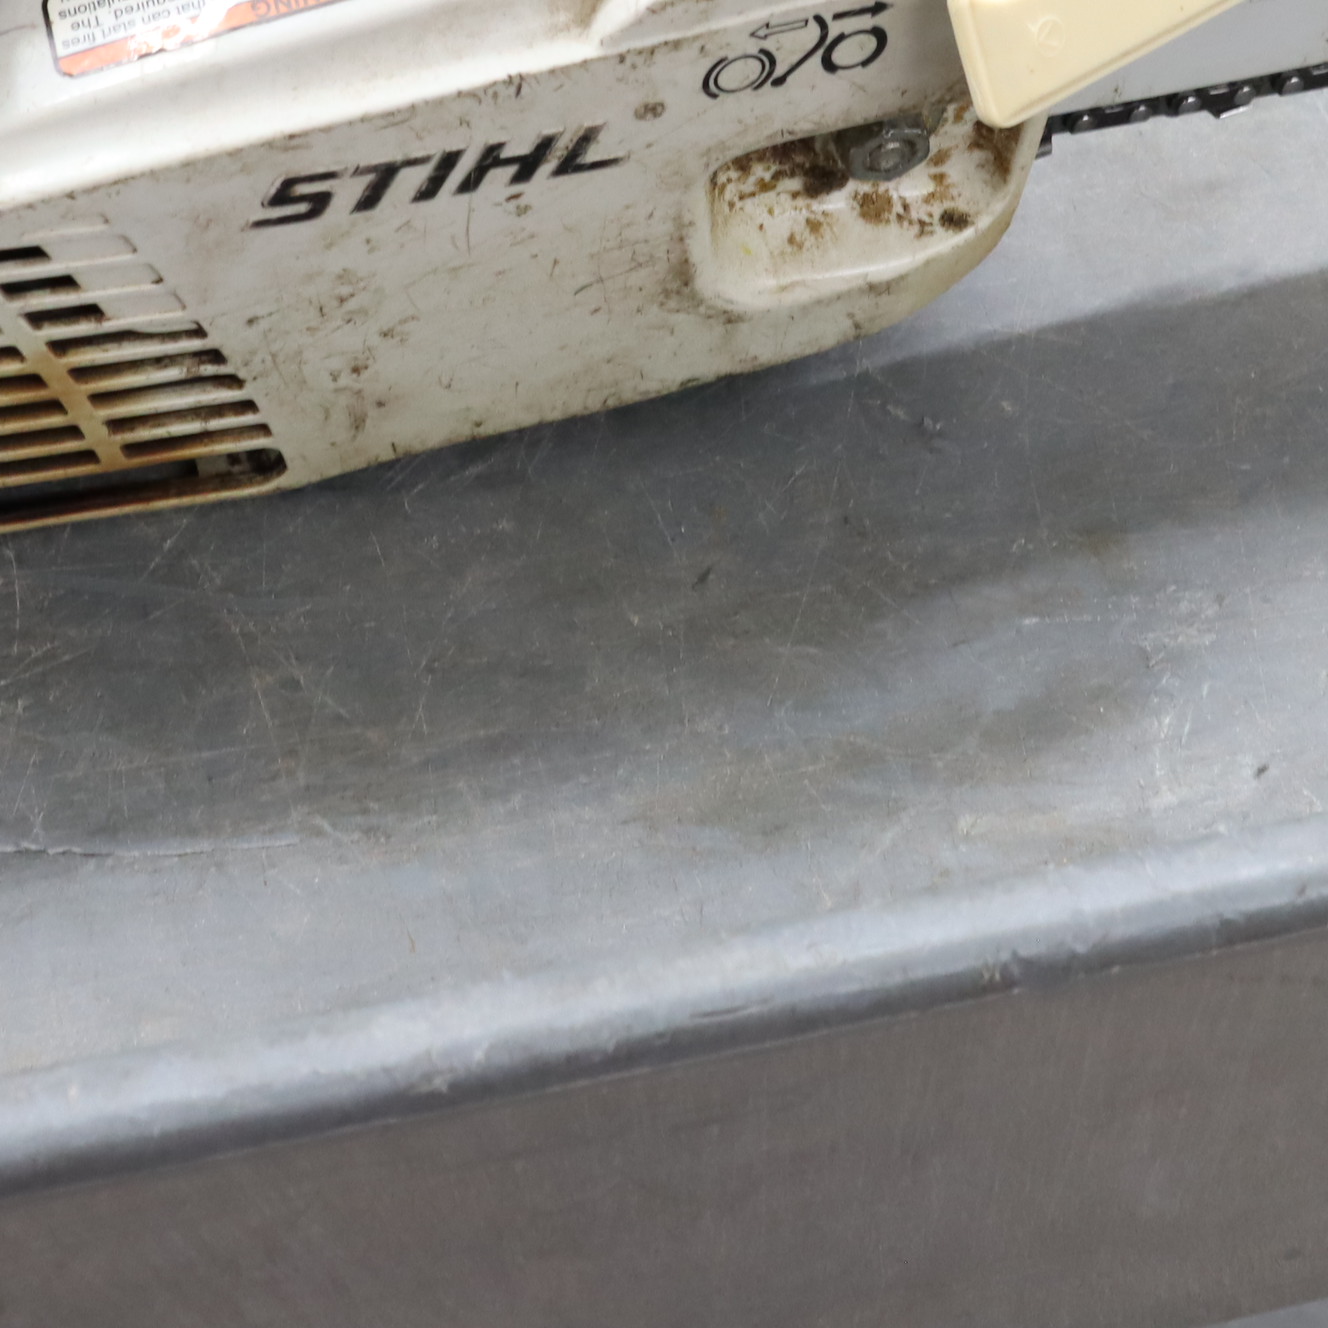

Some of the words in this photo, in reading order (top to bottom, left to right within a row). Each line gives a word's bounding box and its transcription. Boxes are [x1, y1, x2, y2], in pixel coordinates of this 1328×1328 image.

[69, 14, 101, 33] The
[140, 7, 171, 25] can
[100, 18, 137, 40] start
[61, 30, 97, 51] fires
[250, 122, 628, 230] STIHL
